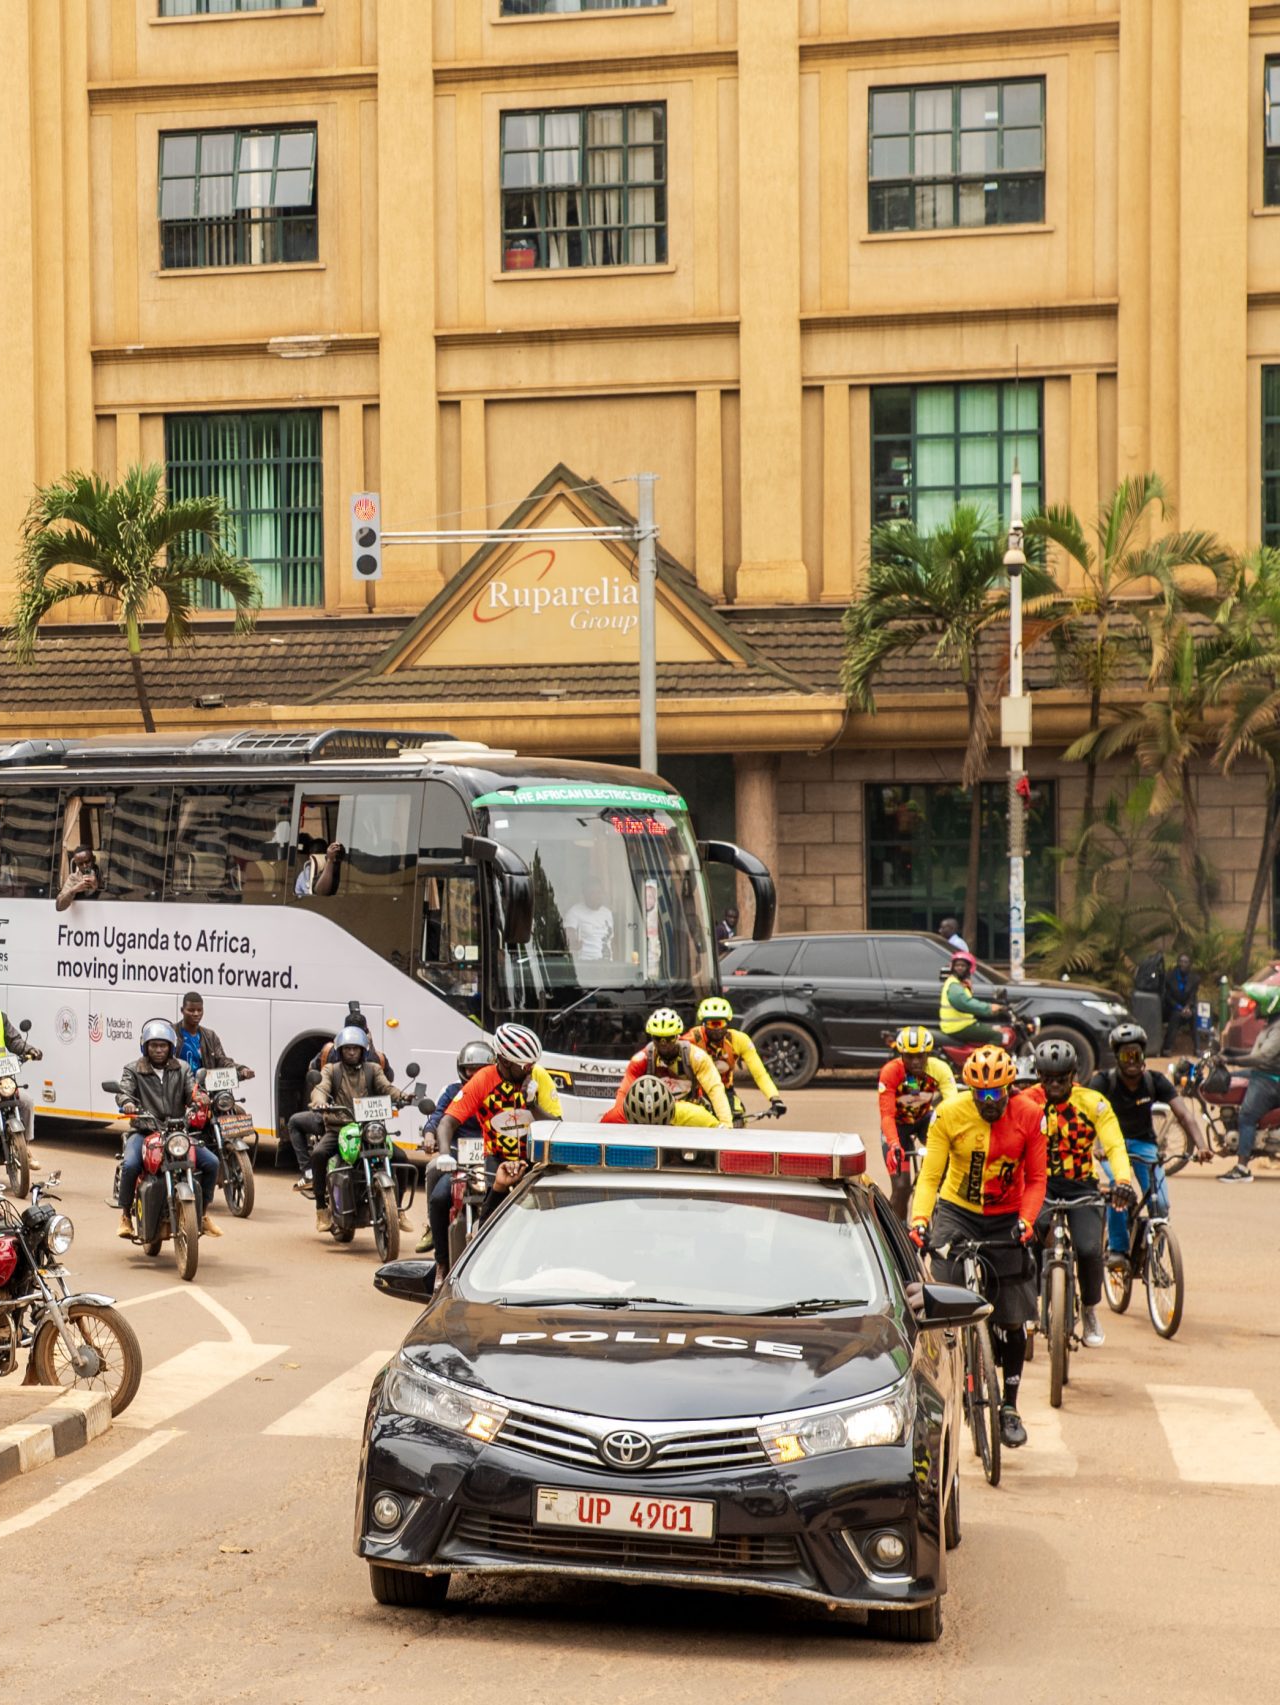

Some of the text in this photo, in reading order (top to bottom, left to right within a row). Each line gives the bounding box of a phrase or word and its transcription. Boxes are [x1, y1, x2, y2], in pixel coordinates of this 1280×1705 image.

[488, 577, 638, 614] Ruparelia
[570, 609, 638, 634] Group
[512, 793, 534, 804] THE
[534, 790, 585, 801] AFRICAN
[585, 789, 631, 801] ELECTRIC
[57, 924, 256, 958] From Uganda to Africa,
[57, 957, 298, 989] moving innovation forward.
[107, 1017, 132, 1028] Made in
[107, 1027, 132, 1041] Uganda
[216, 1071, 230, 1079] UMA
[367, 1100, 383, 1108] UMA
[499, 1331, 804, 1359] POLICE
[578, 1496, 693, 1533] UP 4901
